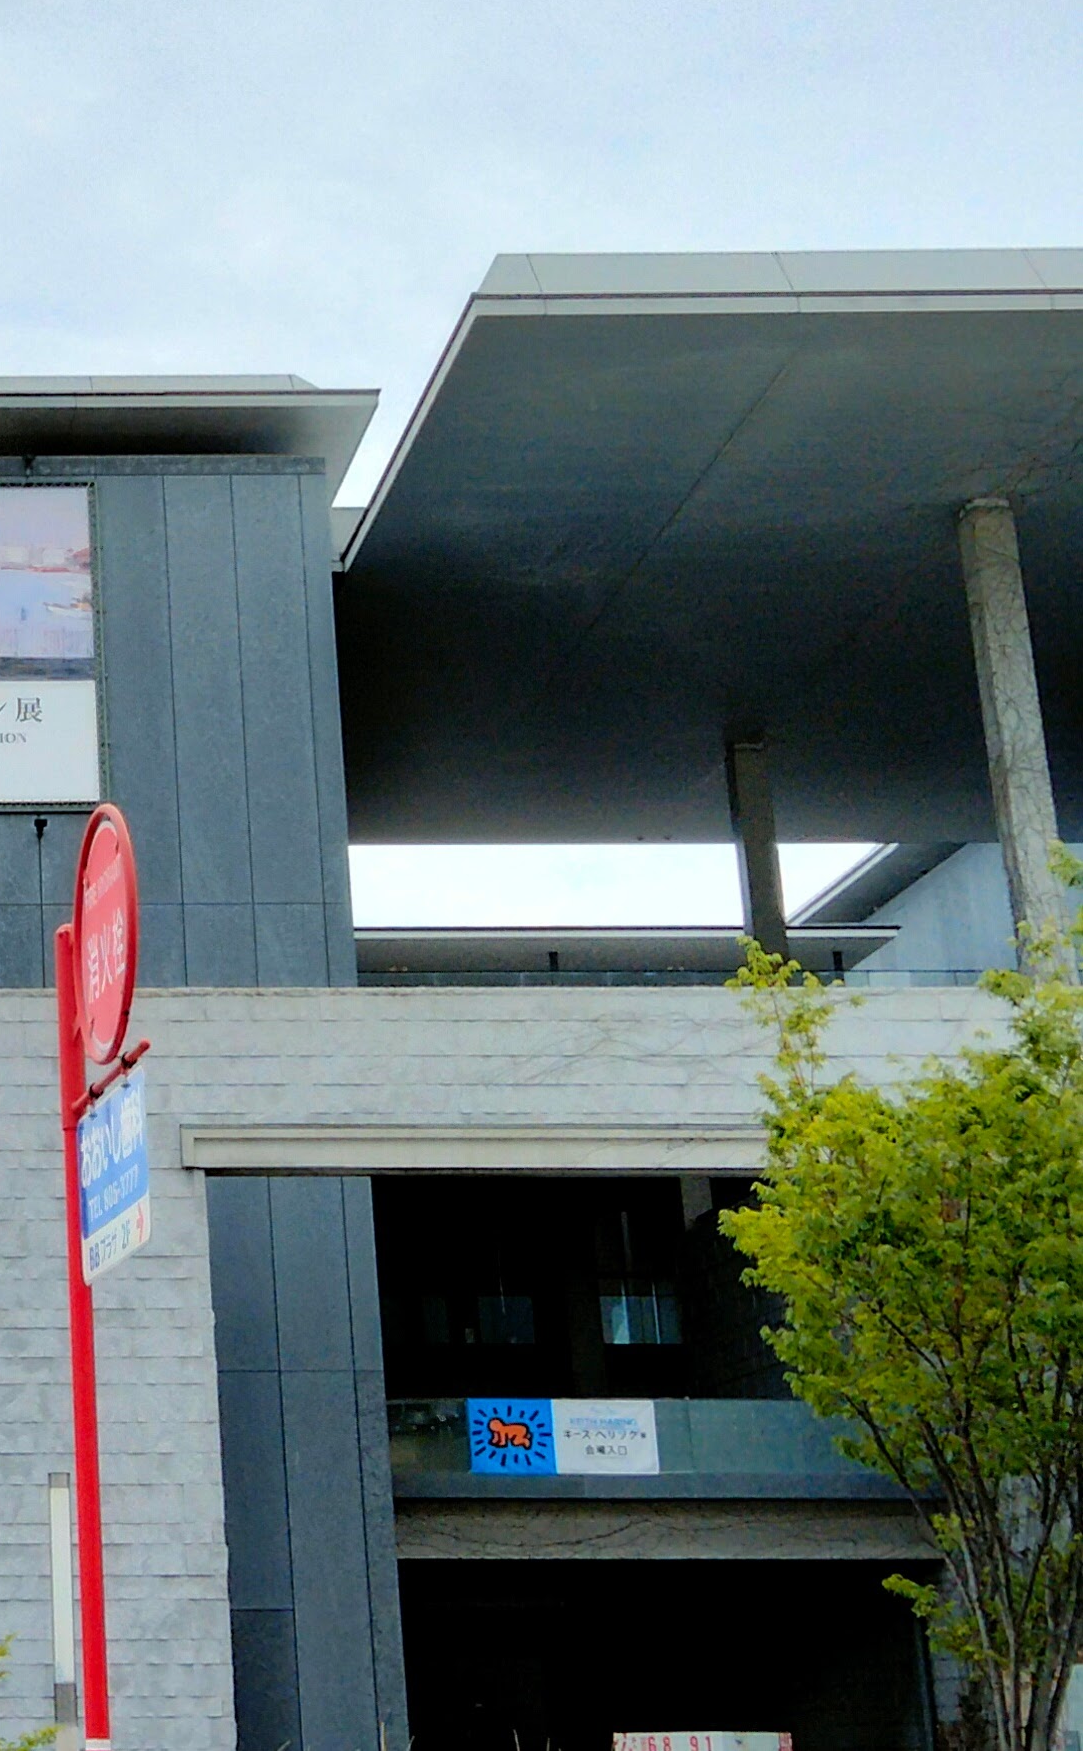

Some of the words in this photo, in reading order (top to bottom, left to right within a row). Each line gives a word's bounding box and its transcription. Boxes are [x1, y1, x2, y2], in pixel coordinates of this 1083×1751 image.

[88, 907, 126, 1004] 消火栓
[88, 1194, 103, 1222] TEL
